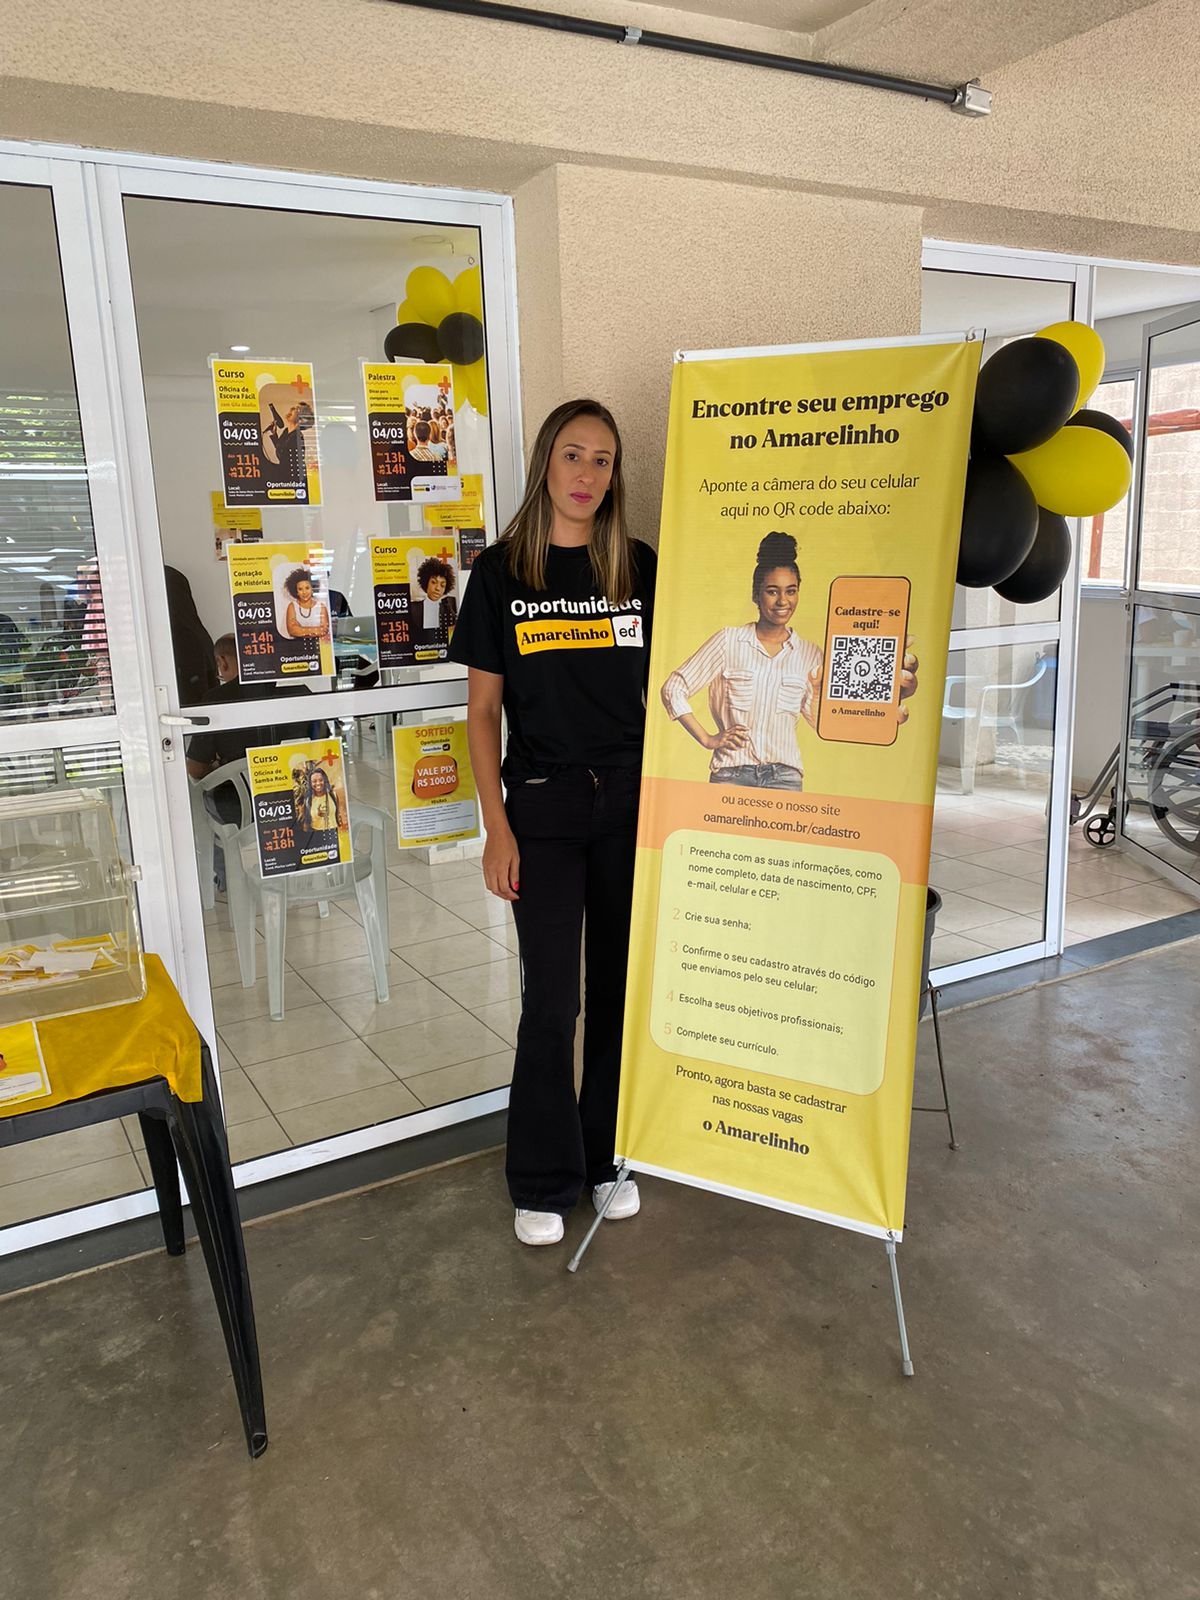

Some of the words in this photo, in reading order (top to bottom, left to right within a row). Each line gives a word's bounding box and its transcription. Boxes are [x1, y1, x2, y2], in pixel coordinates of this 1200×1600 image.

[218, 369, 245, 379] Curso
[368, 373, 396, 381] Palestra
[692, 397, 792, 418] Encontre
[797, 396, 836, 414] seu
[842, 390, 949, 414] emprego
[223, 428, 258, 441] 04/03
[372, 427, 404, 439] 04/03
[730, 432, 756, 450] no
[762, 424, 899, 448] Amarelinho
[236, 454, 260, 466] 11h
[384, 452, 406, 463] 13h
[237, 467, 261, 478] 12h
[385, 463, 406, 475] 14h
[266, 481, 306, 491] Oportunidade
[699, 478, 747, 495] Aponte
[751, 482, 759, 491] a
[764, 478, 814, 491] câmera
[819, 476, 836, 490] do
[841, 479, 866, 489] seu
[870, 474, 919, 488] celular
[721, 502, 748, 519] aqui
[752, 506, 769, 517] no
[774, 502, 795, 517] QR
[799, 502, 833, 515] code
[838, 501, 890, 515] abaixo:
[374, 546, 397, 554] Curso
[377, 598, 408, 610] 04/03
[238, 607, 272, 619] 04/03
[835, 607, 900, 616] Cadastre-se
[388, 621, 408, 632] 15h
[853, 620, 879, 630] aqui!
[251, 631, 273, 643] 14h
[389, 632, 409, 643] 16h
[521, 628, 609, 645] Amarelinho
[252, 643, 274, 655] 15h
[280, 654, 318, 663] Oportunidade
[838, 707, 885, 717] Amarelinho
[415, 726, 454, 738] SORTEIO
[253, 755, 278, 764] Curso
[417, 767, 438, 776] VALE
[441, 765, 454, 773] PIX
[258, 799, 268, 807] dia
[722, 795, 735, 805] ou
[738, 797, 773, 809] acesse
[776, 802, 783, 810] o
[786, 803, 817, 815] nosso
[821, 803, 840, 816] site
[259, 804, 292, 818] 04/03
[704, 813, 860, 840] oamarelinho.com.br/cadastro
[271, 827, 294, 840] 17h
[273, 838, 295, 850] 18h
[300, 844, 337, 855] Oportunidade
[690, 847, 731, 860] Preencha
[733, 853, 752, 863] com
[755, 856, 765, 865] as
[768, 857, 789, 868] suas
[792, 859, 853, 878] informações,
[855, 870, 882, 881] como
[689, 864, 713, 874] nome
[715, 867, 758, 881] completo,
[761, 871, 780, 883] data
[783, 874, 794, 885] de
[797, 878, 854, 895] nascimento,
[857, 886, 877, 898] CPF,
[687, 880, 717, 893] e-mail,
[720, 883, 749, 896] celular
[751, 889, 756, 897] e
[759, 889, 779, 900] CEP;
[673, 908, 680, 920] 2
[685, 911, 702, 922] Crie
[704, 915, 720, 925] sua
[723, 917, 751, 931] senha;
[670, 941, 678, 952] 3
[682, 945, 721, 960] Confirme
[724, 952, 729, 960] o
[732, 954, 747, 964] seu
[750, 956, 789, 971] cadastro
[792, 965, 826, 978] através
[829, 969, 841, 980] do
[843, 973, 875, 988] código
[681, 961, 697, 974] que
[700, 965, 741, 979] enviamos
[744, 972, 763, 984] pelo
[765, 977, 781, 987] seu
[784, 979, 818, 994] celular;
[666, 990, 674, 1002] 4
[679, 994, 713, 1008] Escolha
[715, 1002, 735, 1013] seus
[738, 1004, 778, 1021] objetivos
[781, 1014, 843, 1035] profissionais;
[664, 1023, 671, 1035] 5
[676, 1026, 717, 1043] Complete
[719, 1037, 735, 1048] seu
[737, 1039, 779, 1056] currículo.
[676, 1065, 712, 1084] Pronto,
[715, 1075, 744, 1089] agora
[747, 1081, 776, 1097] basta
[779, 1091, 791, 1100] se
[794, 1094, 846, 1113] cadastrar
[712, 1094, 730, 1106] nas
[733, 1099, 769, 1116] nossas
[772, 1108, 803, 1124] vagas
[703, 1120, 712, 1130] o
[715, 1120, 810, 1155] Amarelinho
